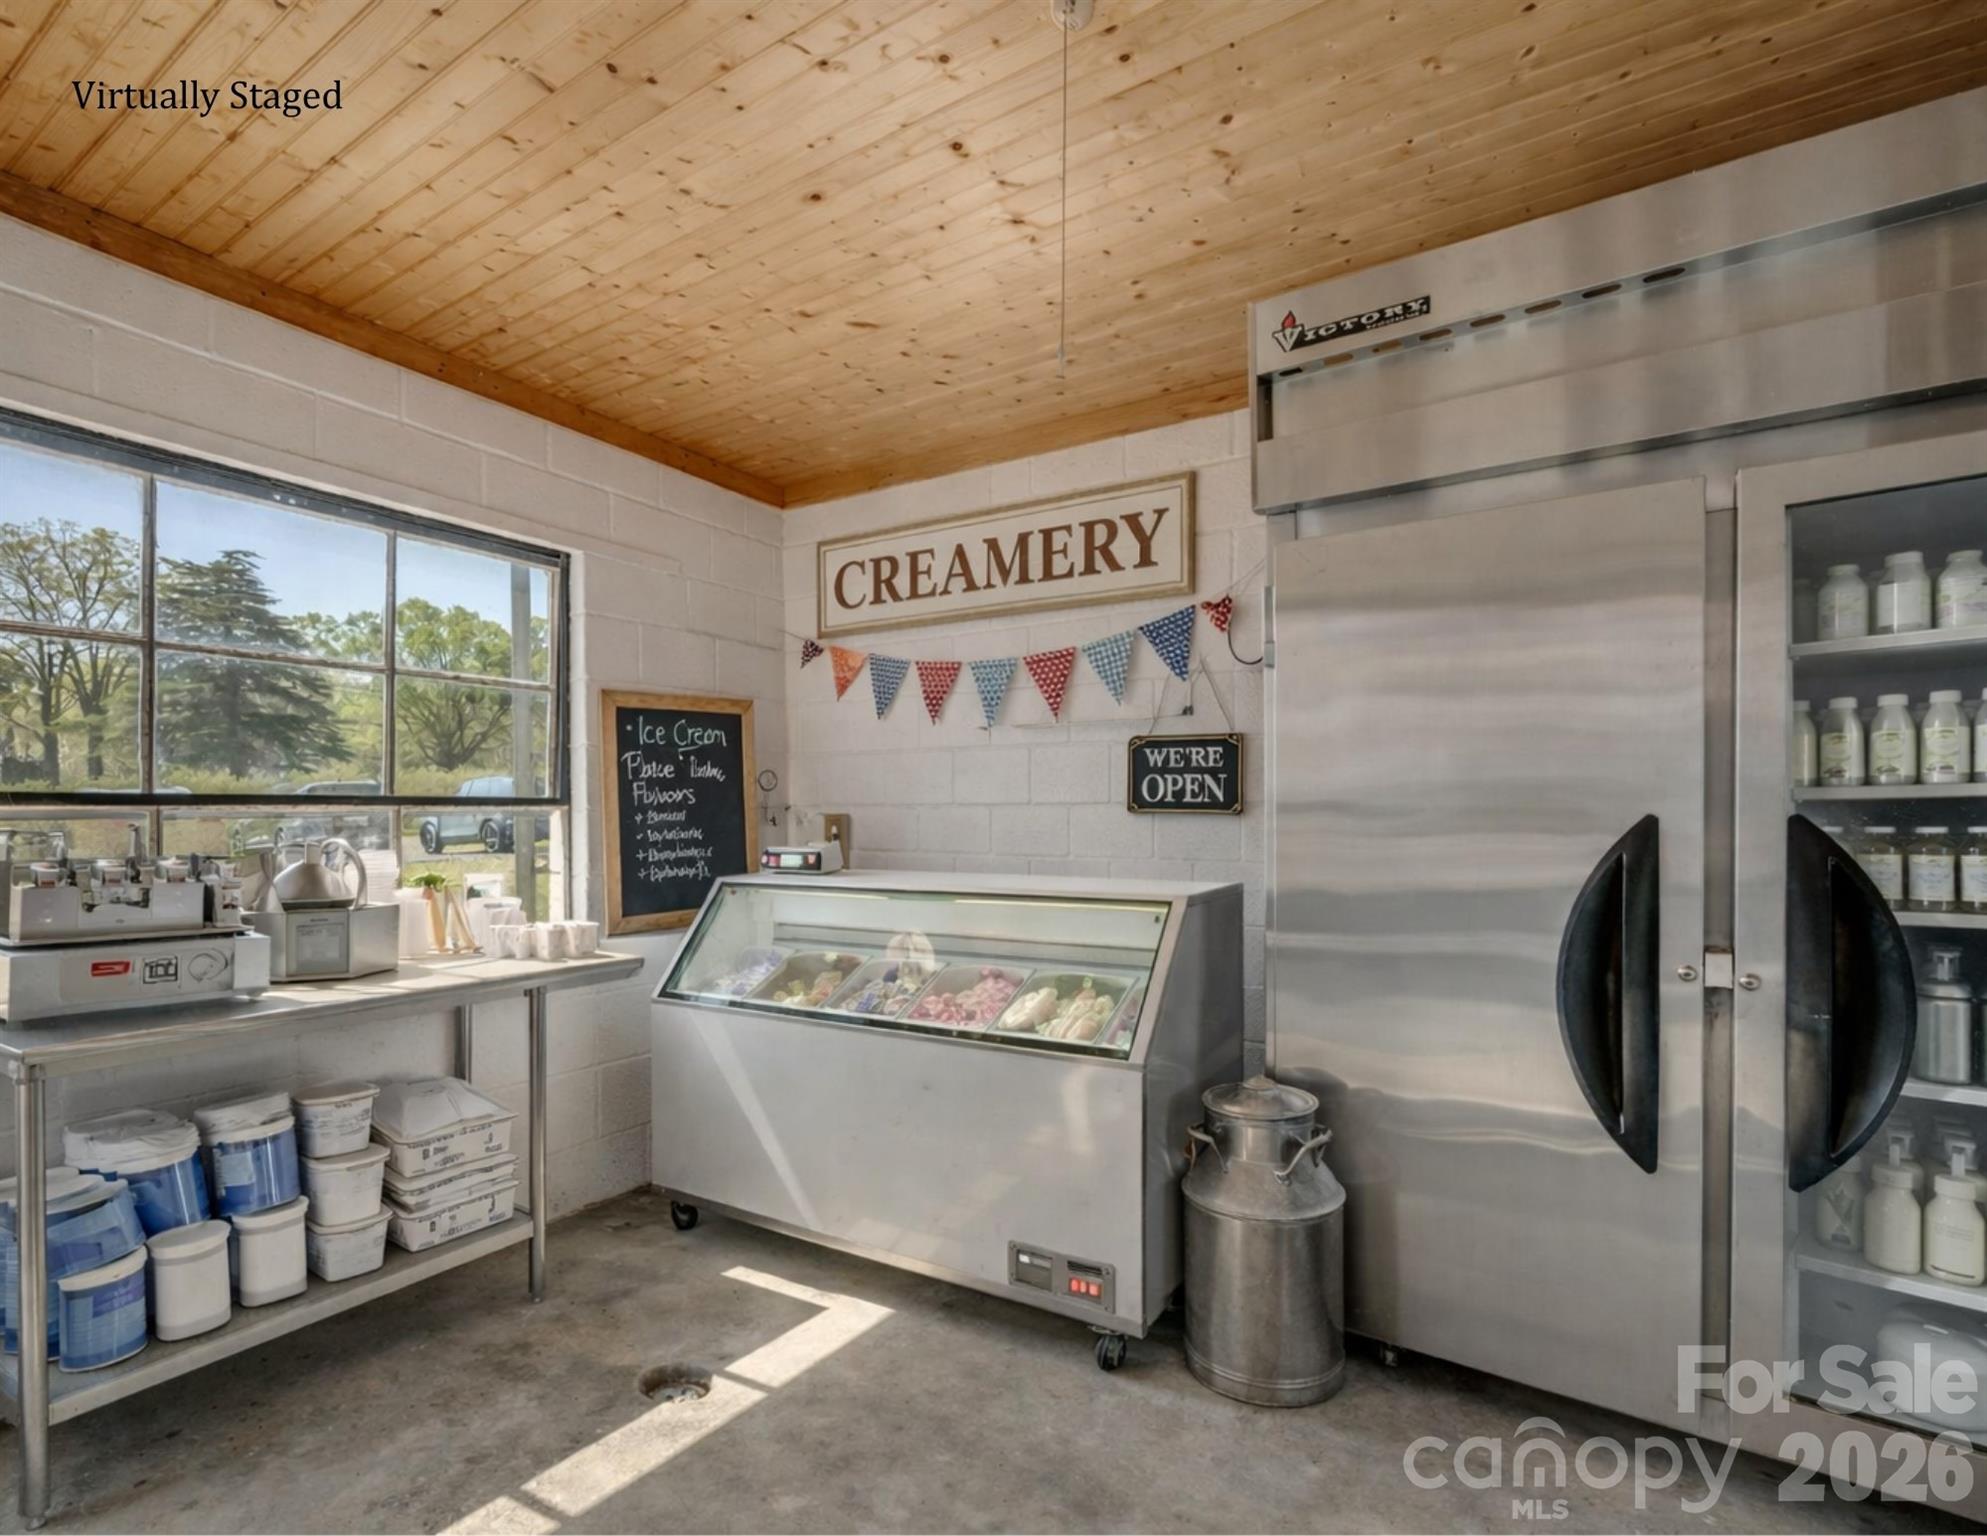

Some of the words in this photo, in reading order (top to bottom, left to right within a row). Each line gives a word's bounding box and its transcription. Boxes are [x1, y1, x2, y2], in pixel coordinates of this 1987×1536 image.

[1273, 299, 1425, 351] VICTORY
[834, 508, 1169, 609] CREAMERY
[638, 715, 666, 745] Ice
[1143, 747, 1224, 767] WE'RE
[1141, 774, 1227, 802] OPEN
